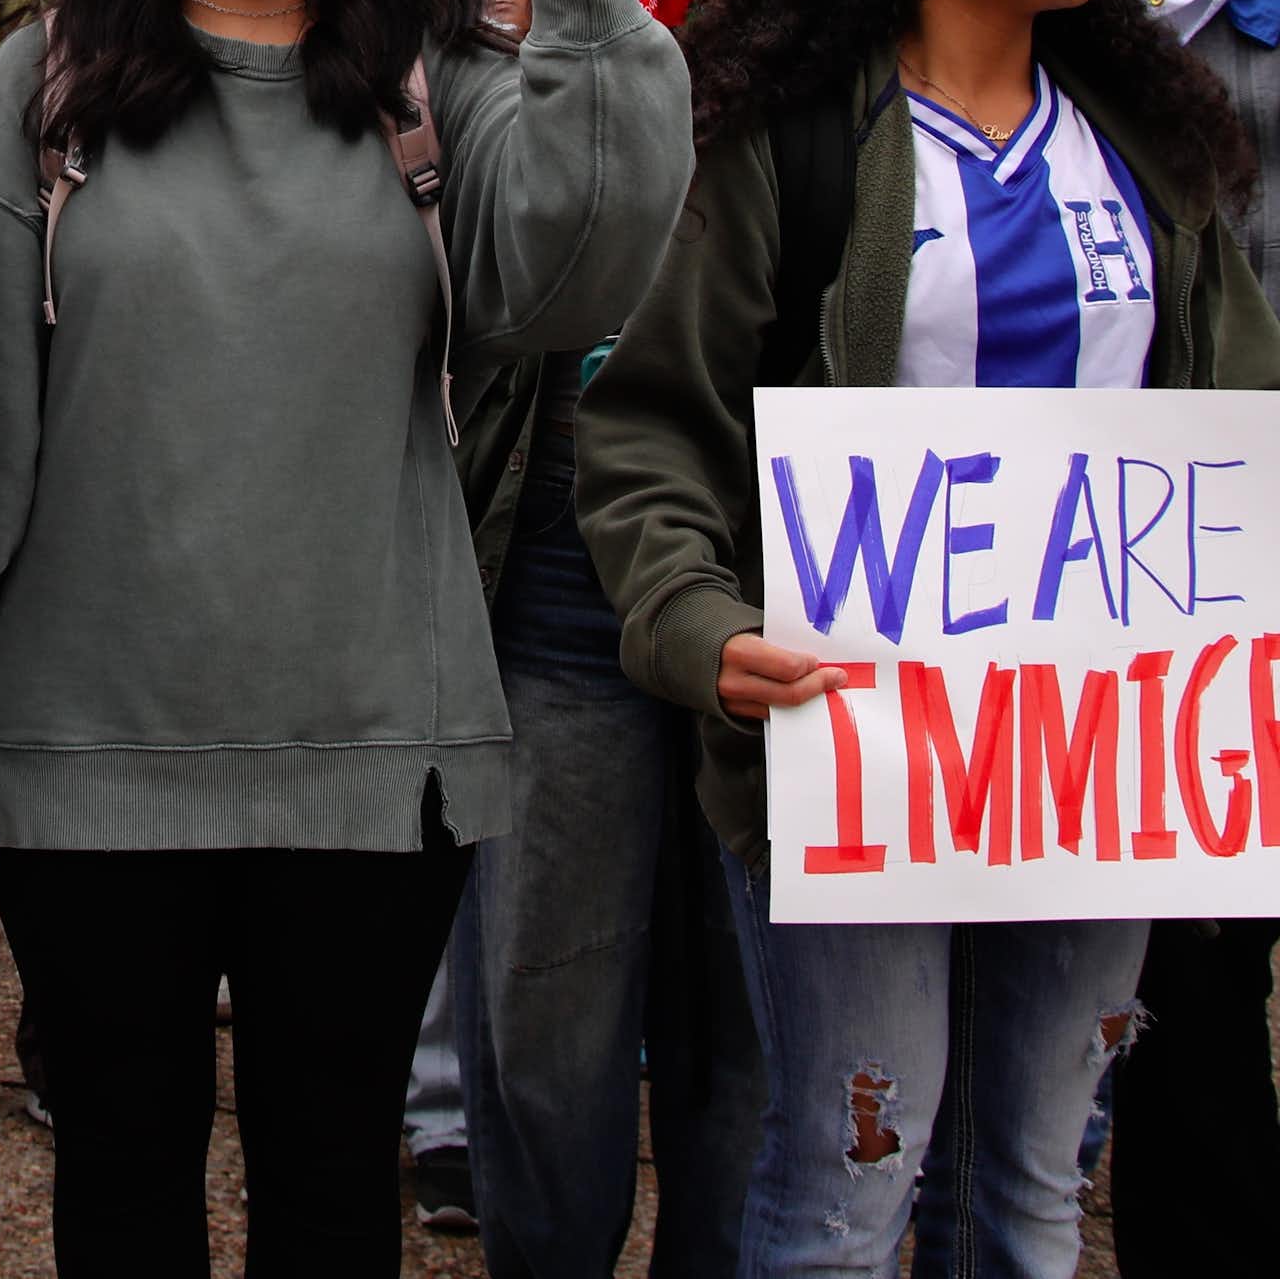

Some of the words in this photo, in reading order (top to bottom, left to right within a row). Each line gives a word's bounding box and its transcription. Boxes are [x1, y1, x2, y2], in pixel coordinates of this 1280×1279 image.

[1076, 211, 1108, 291] HONDURAS
[770, 448, 1008, 646] WE
[1031, 452, 1246, 627] ARE
